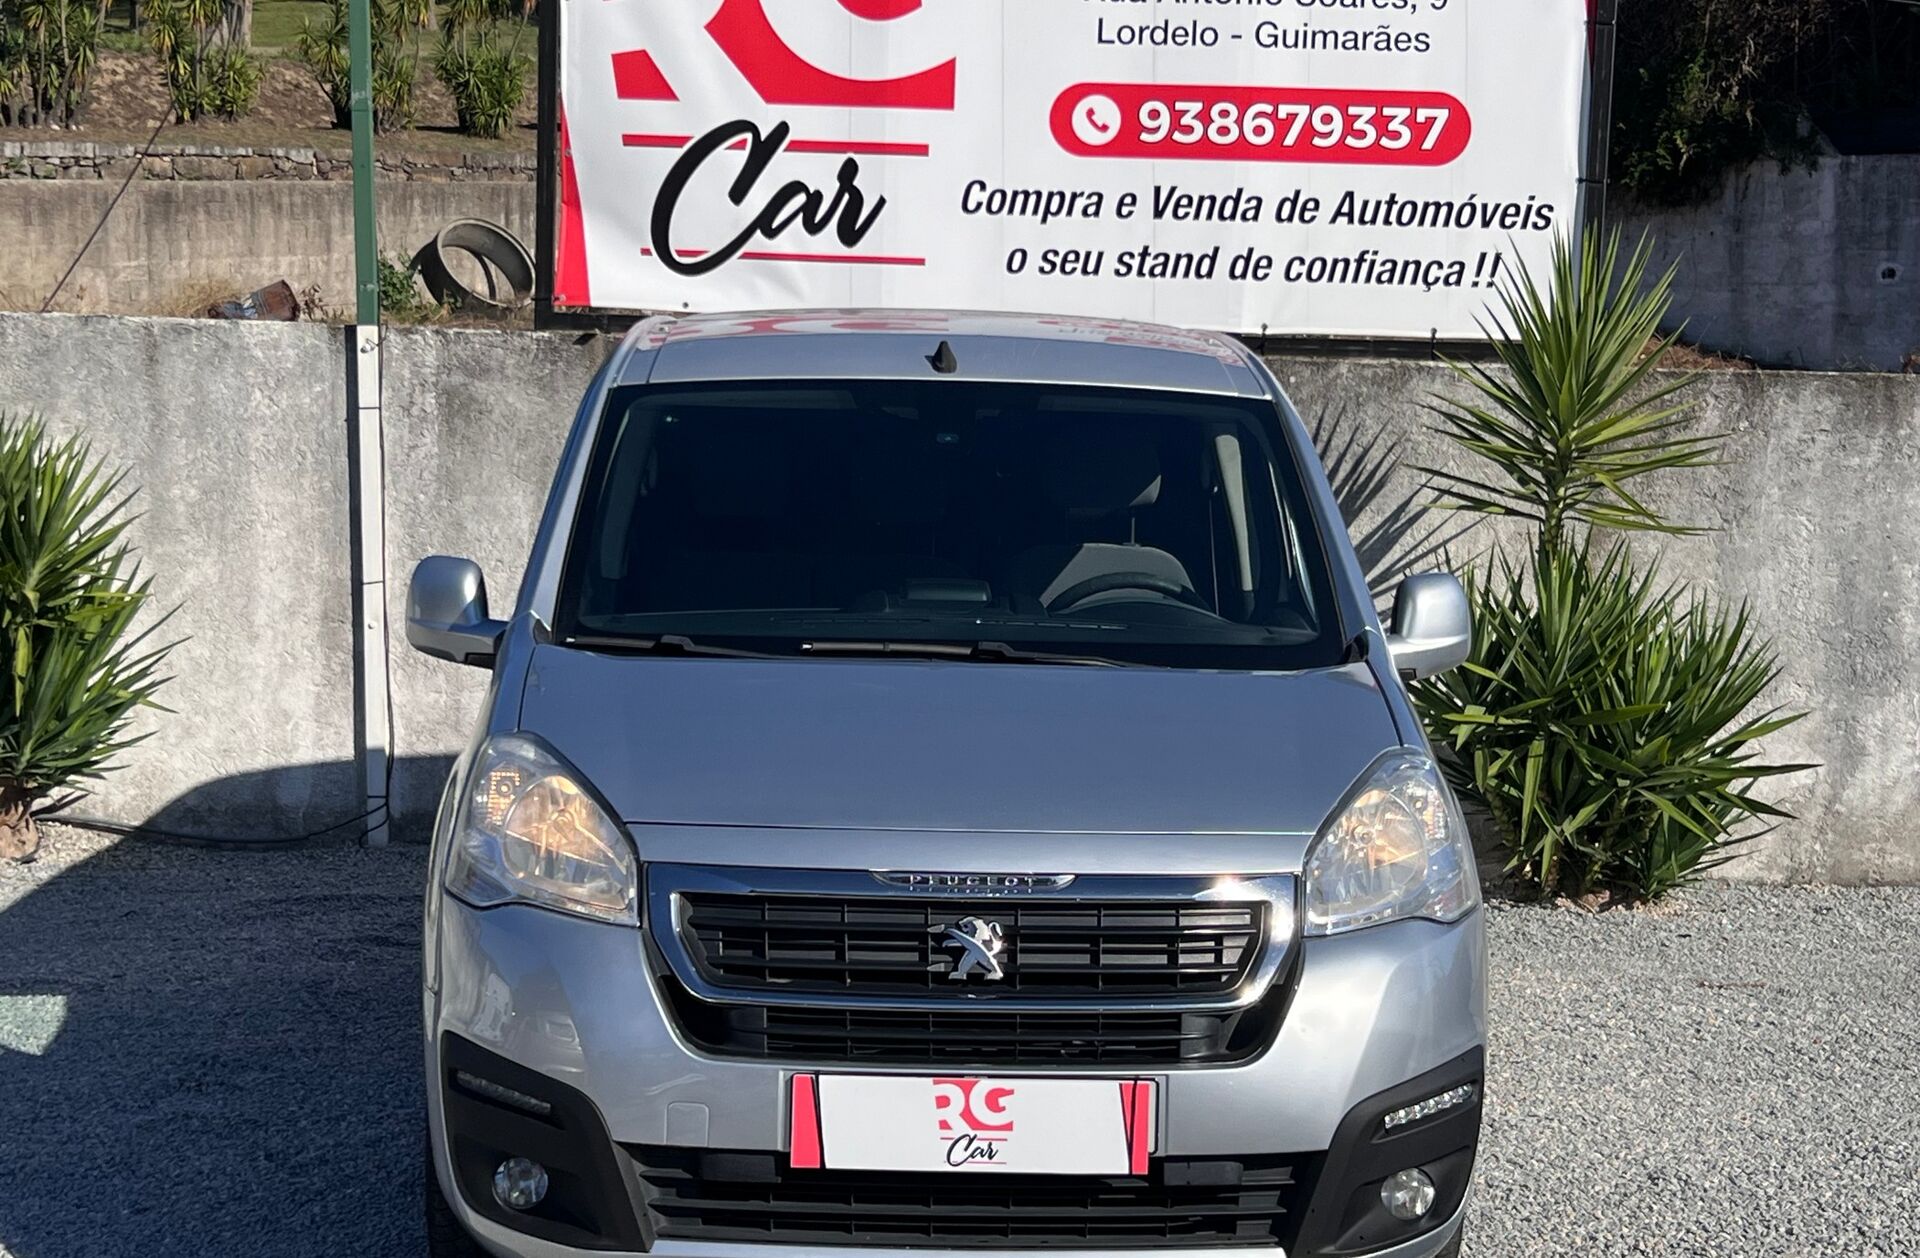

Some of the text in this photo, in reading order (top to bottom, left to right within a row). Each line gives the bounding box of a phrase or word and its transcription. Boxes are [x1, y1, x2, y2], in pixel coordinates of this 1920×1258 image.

[1097, 17, 1219, 47] Lordelo
[1254, 21, 1430, 53] Guimarães
[1138, 100, 1450, 150] 938679337
[650, 119, 887, 277] Car
[961, 179, 1554, 231] Compra e Venda de Automóveis
[1006, 248, 1028, 274] o
[1038, 249, 1105, 276] seu
[1113, 245, 1221, 280] stand
[1228, 246, 1273, 282] de
[932, 1079, 1014, 1131] RG
[946, 1133, 999, 1167] Car
